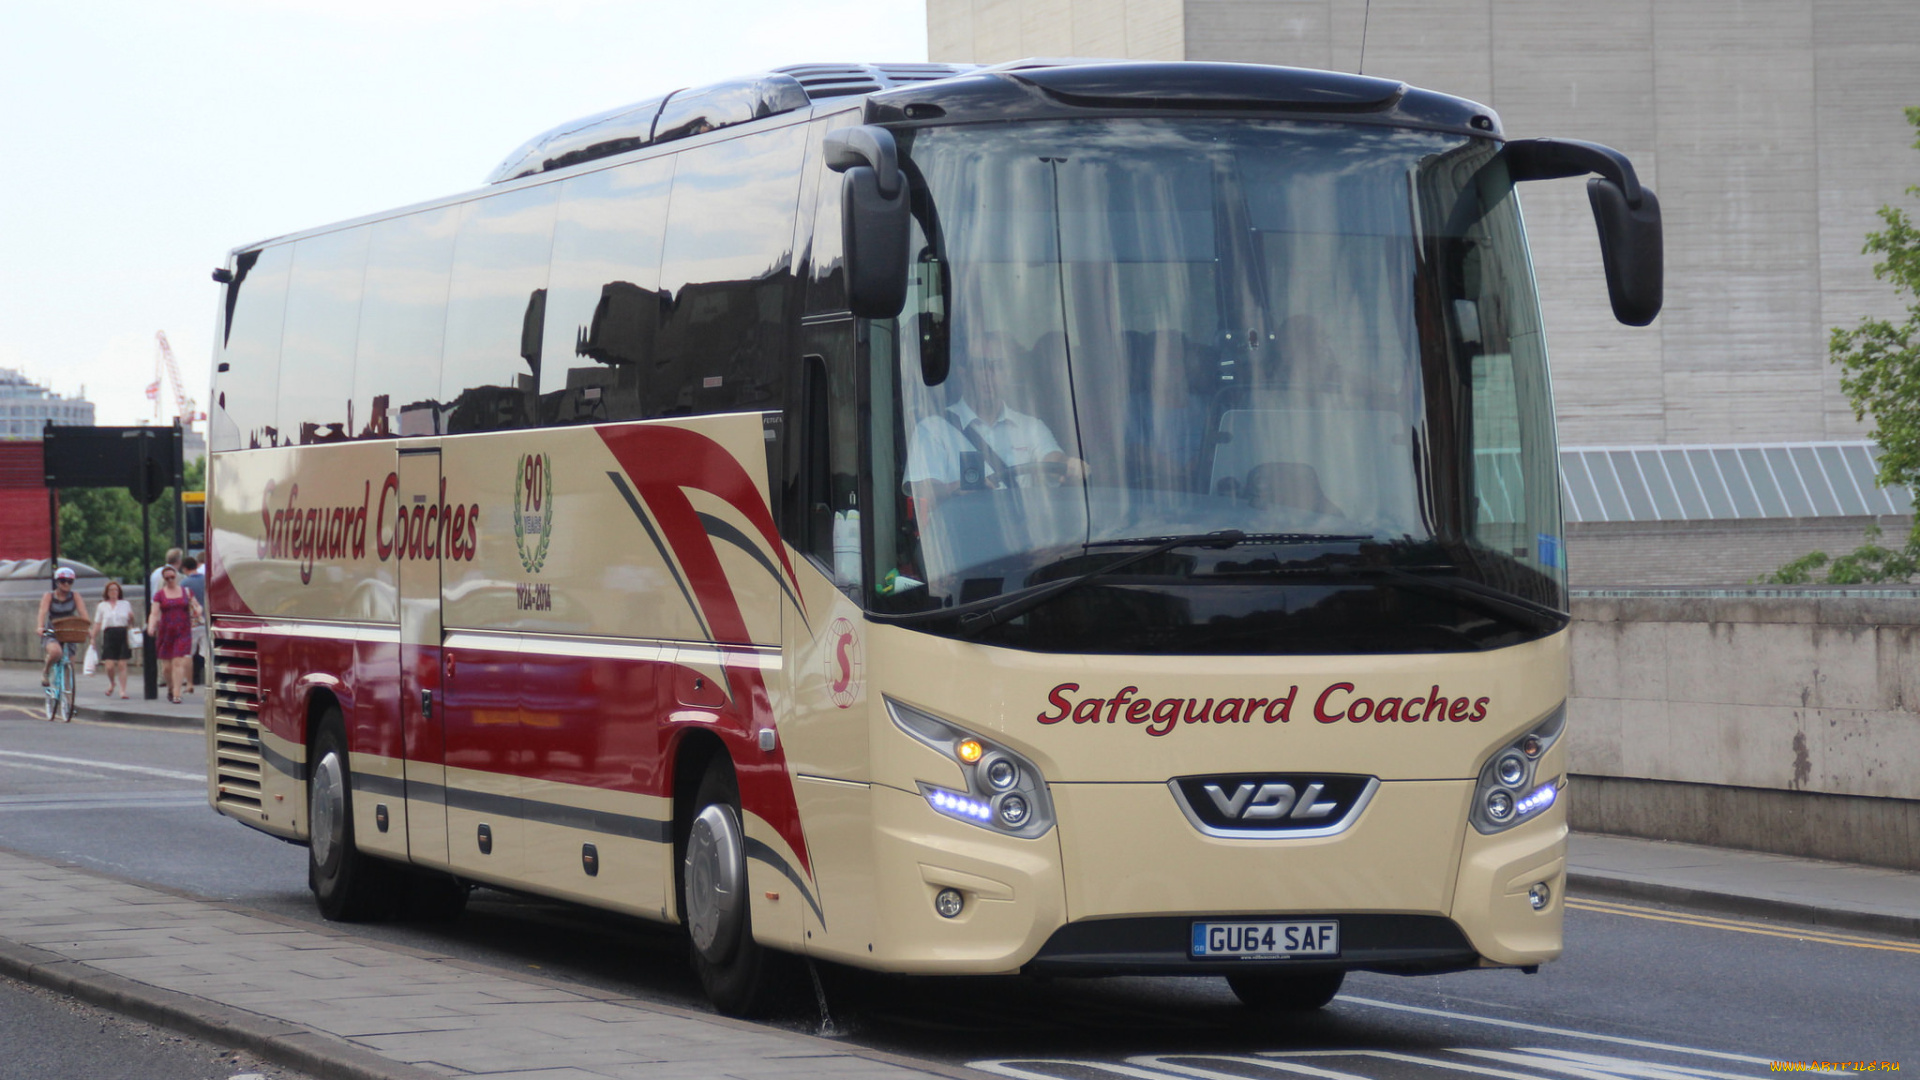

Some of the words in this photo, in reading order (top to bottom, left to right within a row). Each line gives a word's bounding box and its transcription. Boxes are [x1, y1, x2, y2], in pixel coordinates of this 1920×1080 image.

[524, 453, 543, 513] 90
[257, 477, 370, 585] Safeguard
[376, 471, 480, 562] Coaches
[516, 582, 552, 612] 1924-2014
[1036, 682, 1299, 737] Safeguard
[1312, 682, 1490, 725] Coaches
[1203, 782, 1338, 820] VDL
[1209, 926, 1276, 952] GU64
[1284, 925, 1334, 951] SAF
